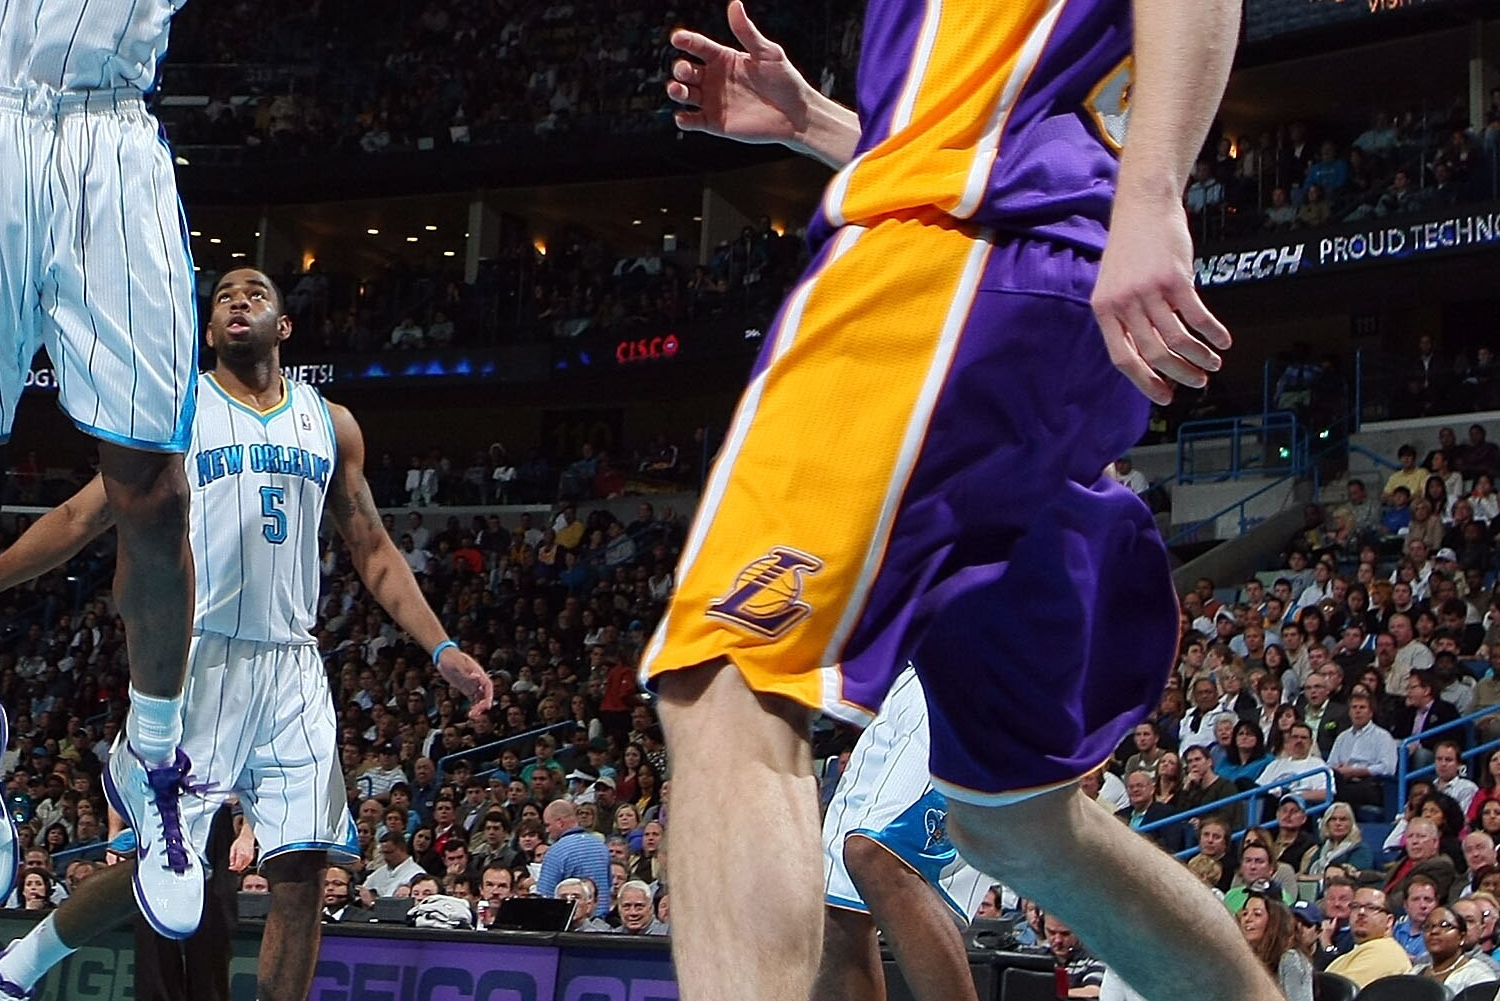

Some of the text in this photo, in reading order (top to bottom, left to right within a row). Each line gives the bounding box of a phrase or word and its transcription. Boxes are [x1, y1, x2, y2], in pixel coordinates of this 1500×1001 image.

[1193, 243, 1305, 287] NSECH
[1319, 227, 1404, 264] PROUD
[279, 364, 334, 384] NETS!
[195, 444, 332, 493] NEW ORLEANS
[259, 486, 288, 545] 5
